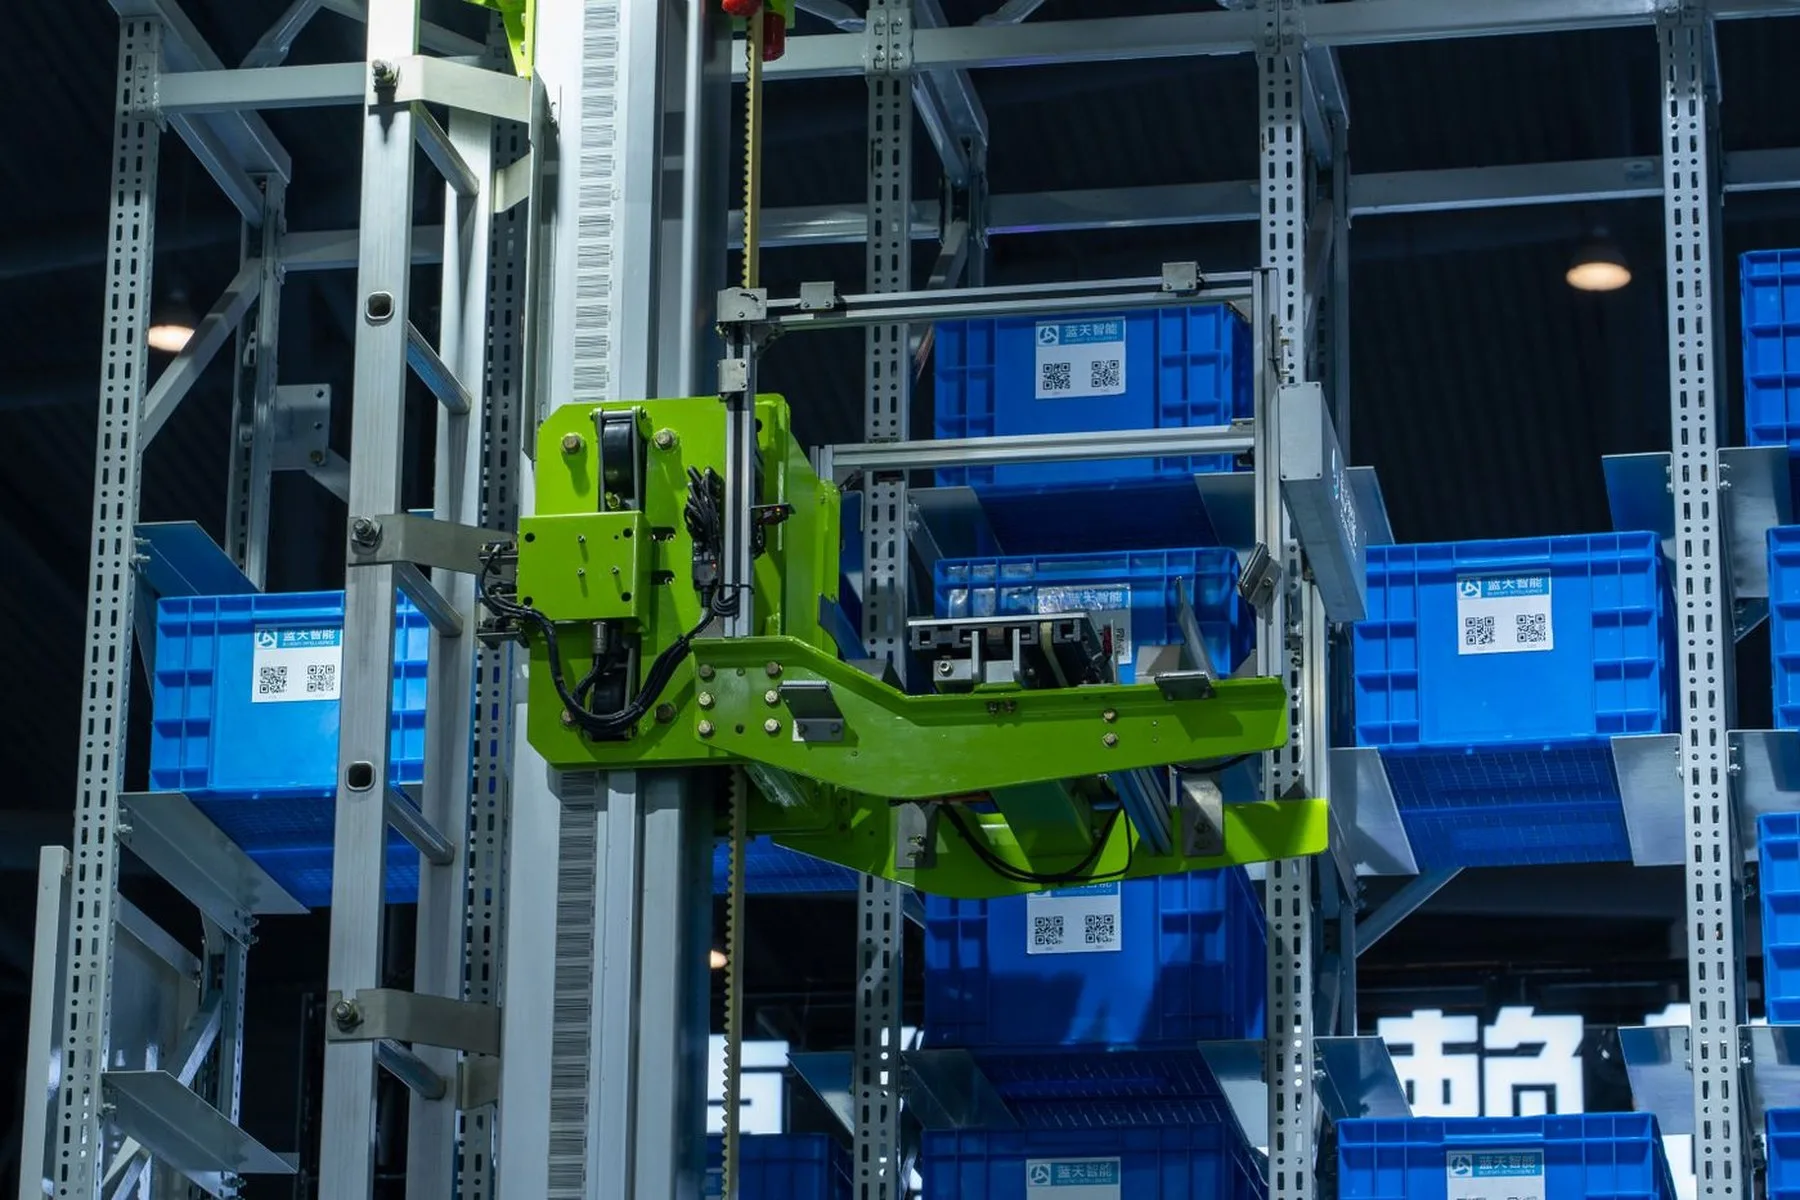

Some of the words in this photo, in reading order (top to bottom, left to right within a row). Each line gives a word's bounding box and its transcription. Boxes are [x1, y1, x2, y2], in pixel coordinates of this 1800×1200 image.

[1064, 322, 1118, 338] 蓝天智能
[1488, 576, 1543, 591] 蓝天智能
[283, 629, 335, 641] 蓝天智能
[1479, 1155, 1535, 1170] 蓝天智能
[1057, 1163, 1113, 1179] 蓝天智能
